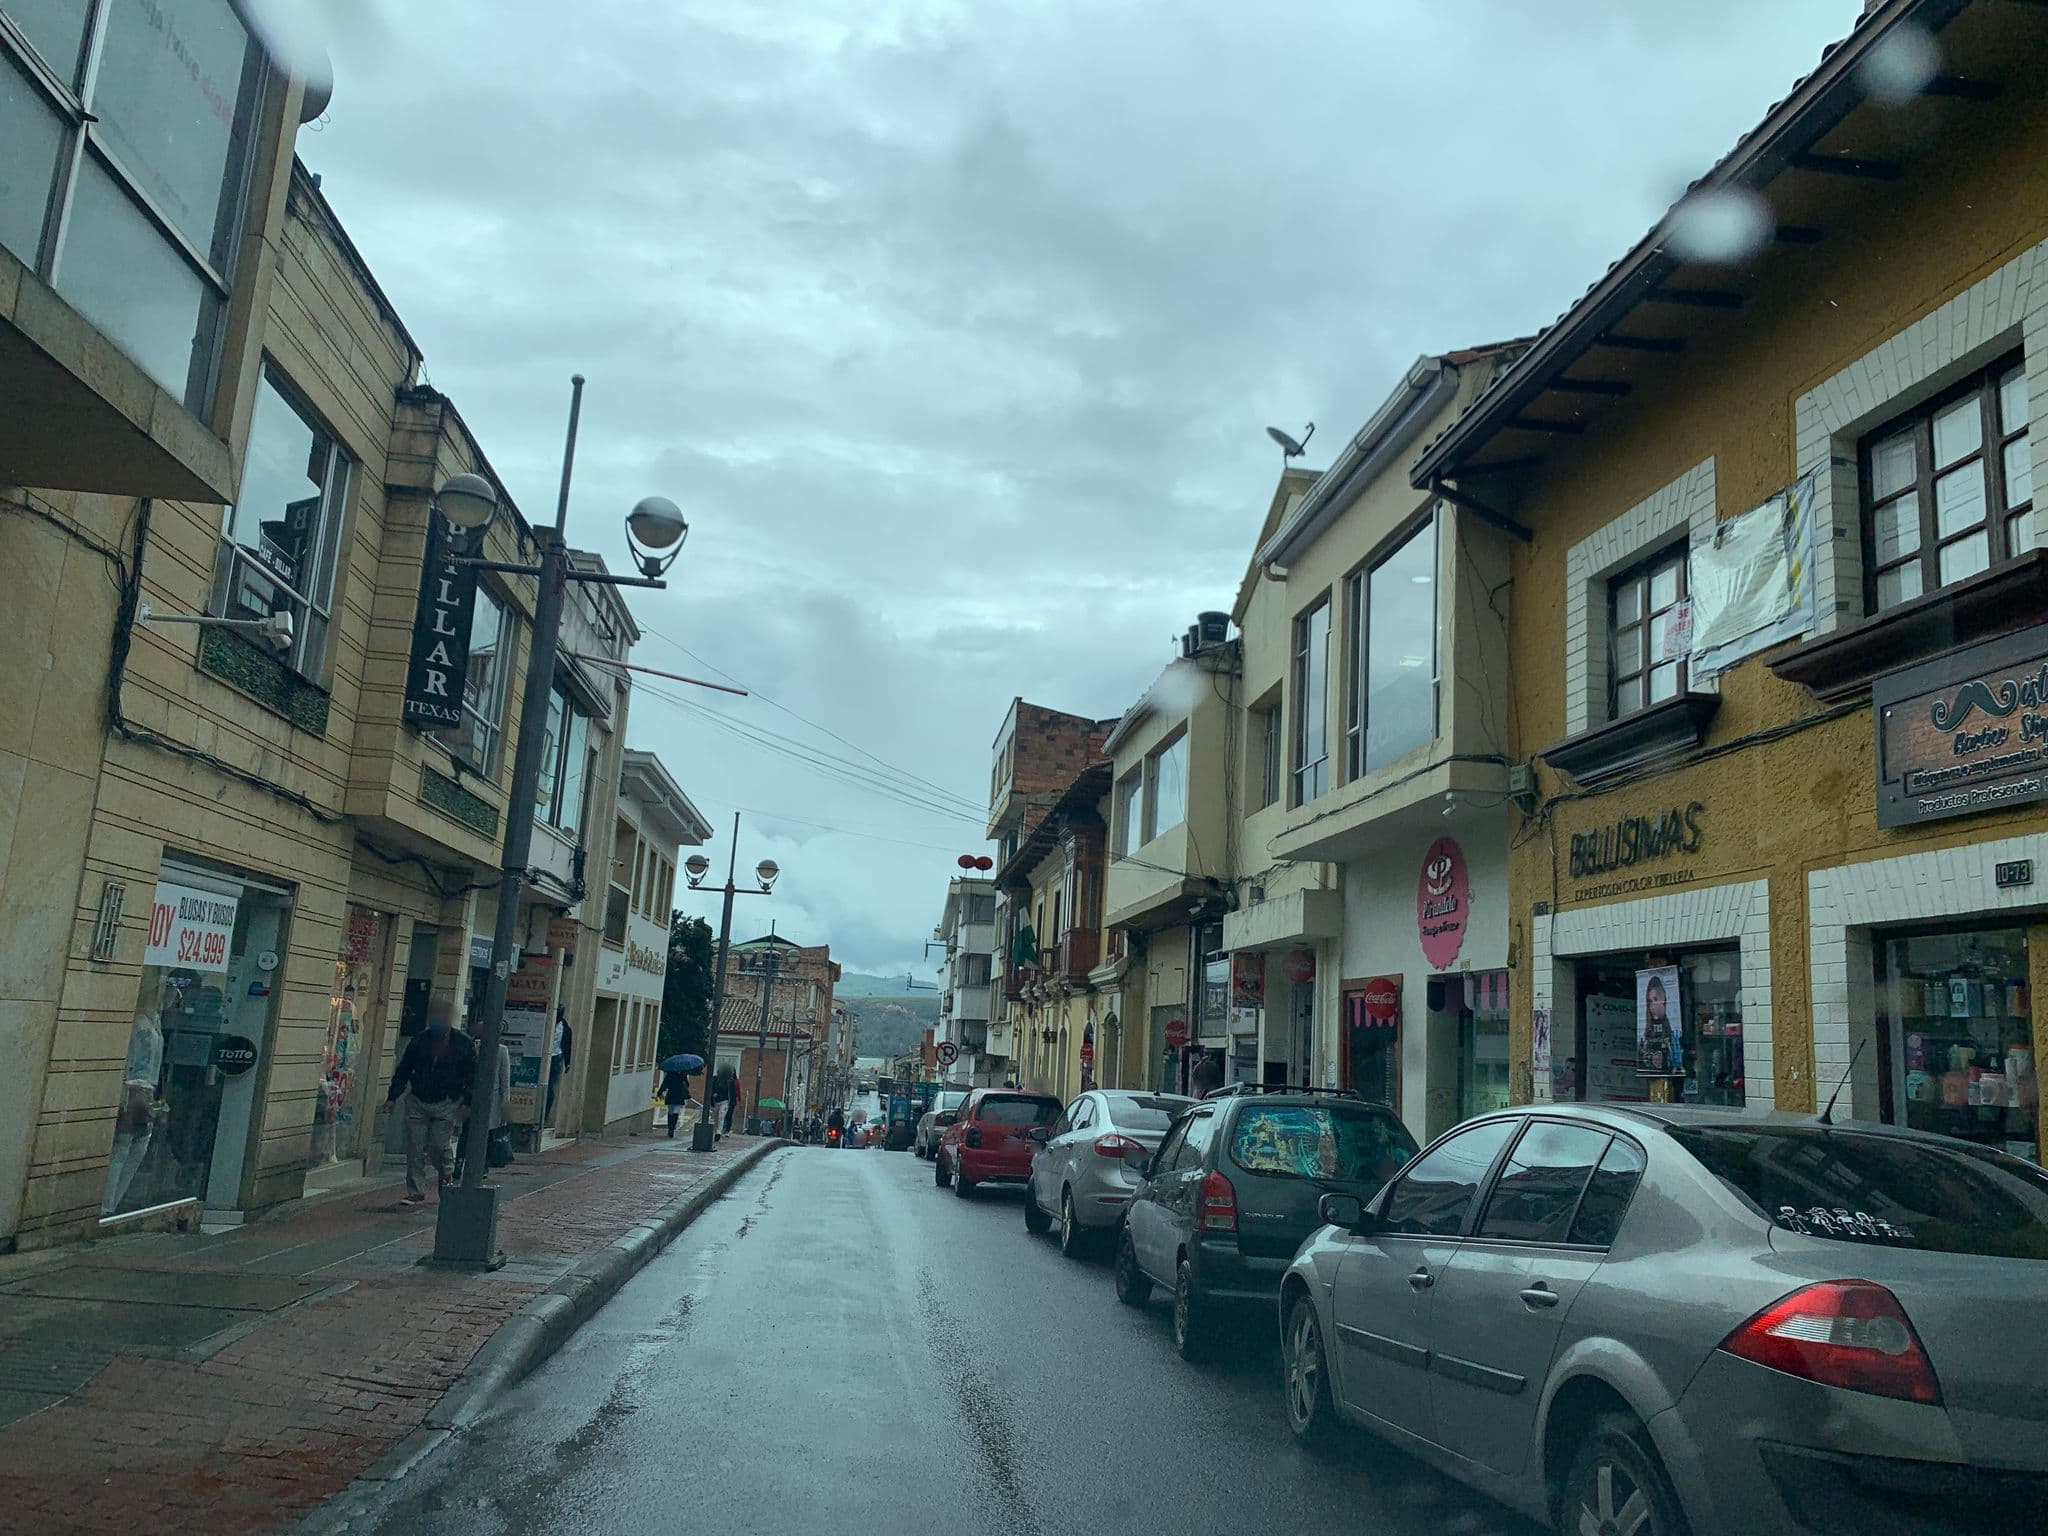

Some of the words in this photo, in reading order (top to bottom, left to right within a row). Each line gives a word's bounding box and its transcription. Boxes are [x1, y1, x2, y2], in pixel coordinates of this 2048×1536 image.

[406, 700, 460, 723] TEXAS
[1953, 727, 2009, 757] Barber
[1918, 794, 1969, 813] Productos
[1971, 778, 2040, 804] Profesionales
[1622, 876, 1654, 893] COLOR
[1997, 863, 2028, 882] 10-73
[179, 896, 208, 923] BLUSAS
[205, 902, 214, 924] Y
[212, 903, 235, 927] BUSOS
[178, 927, 226, 965] $24.999
[218, 1048, 253, 1060] TOTTO
